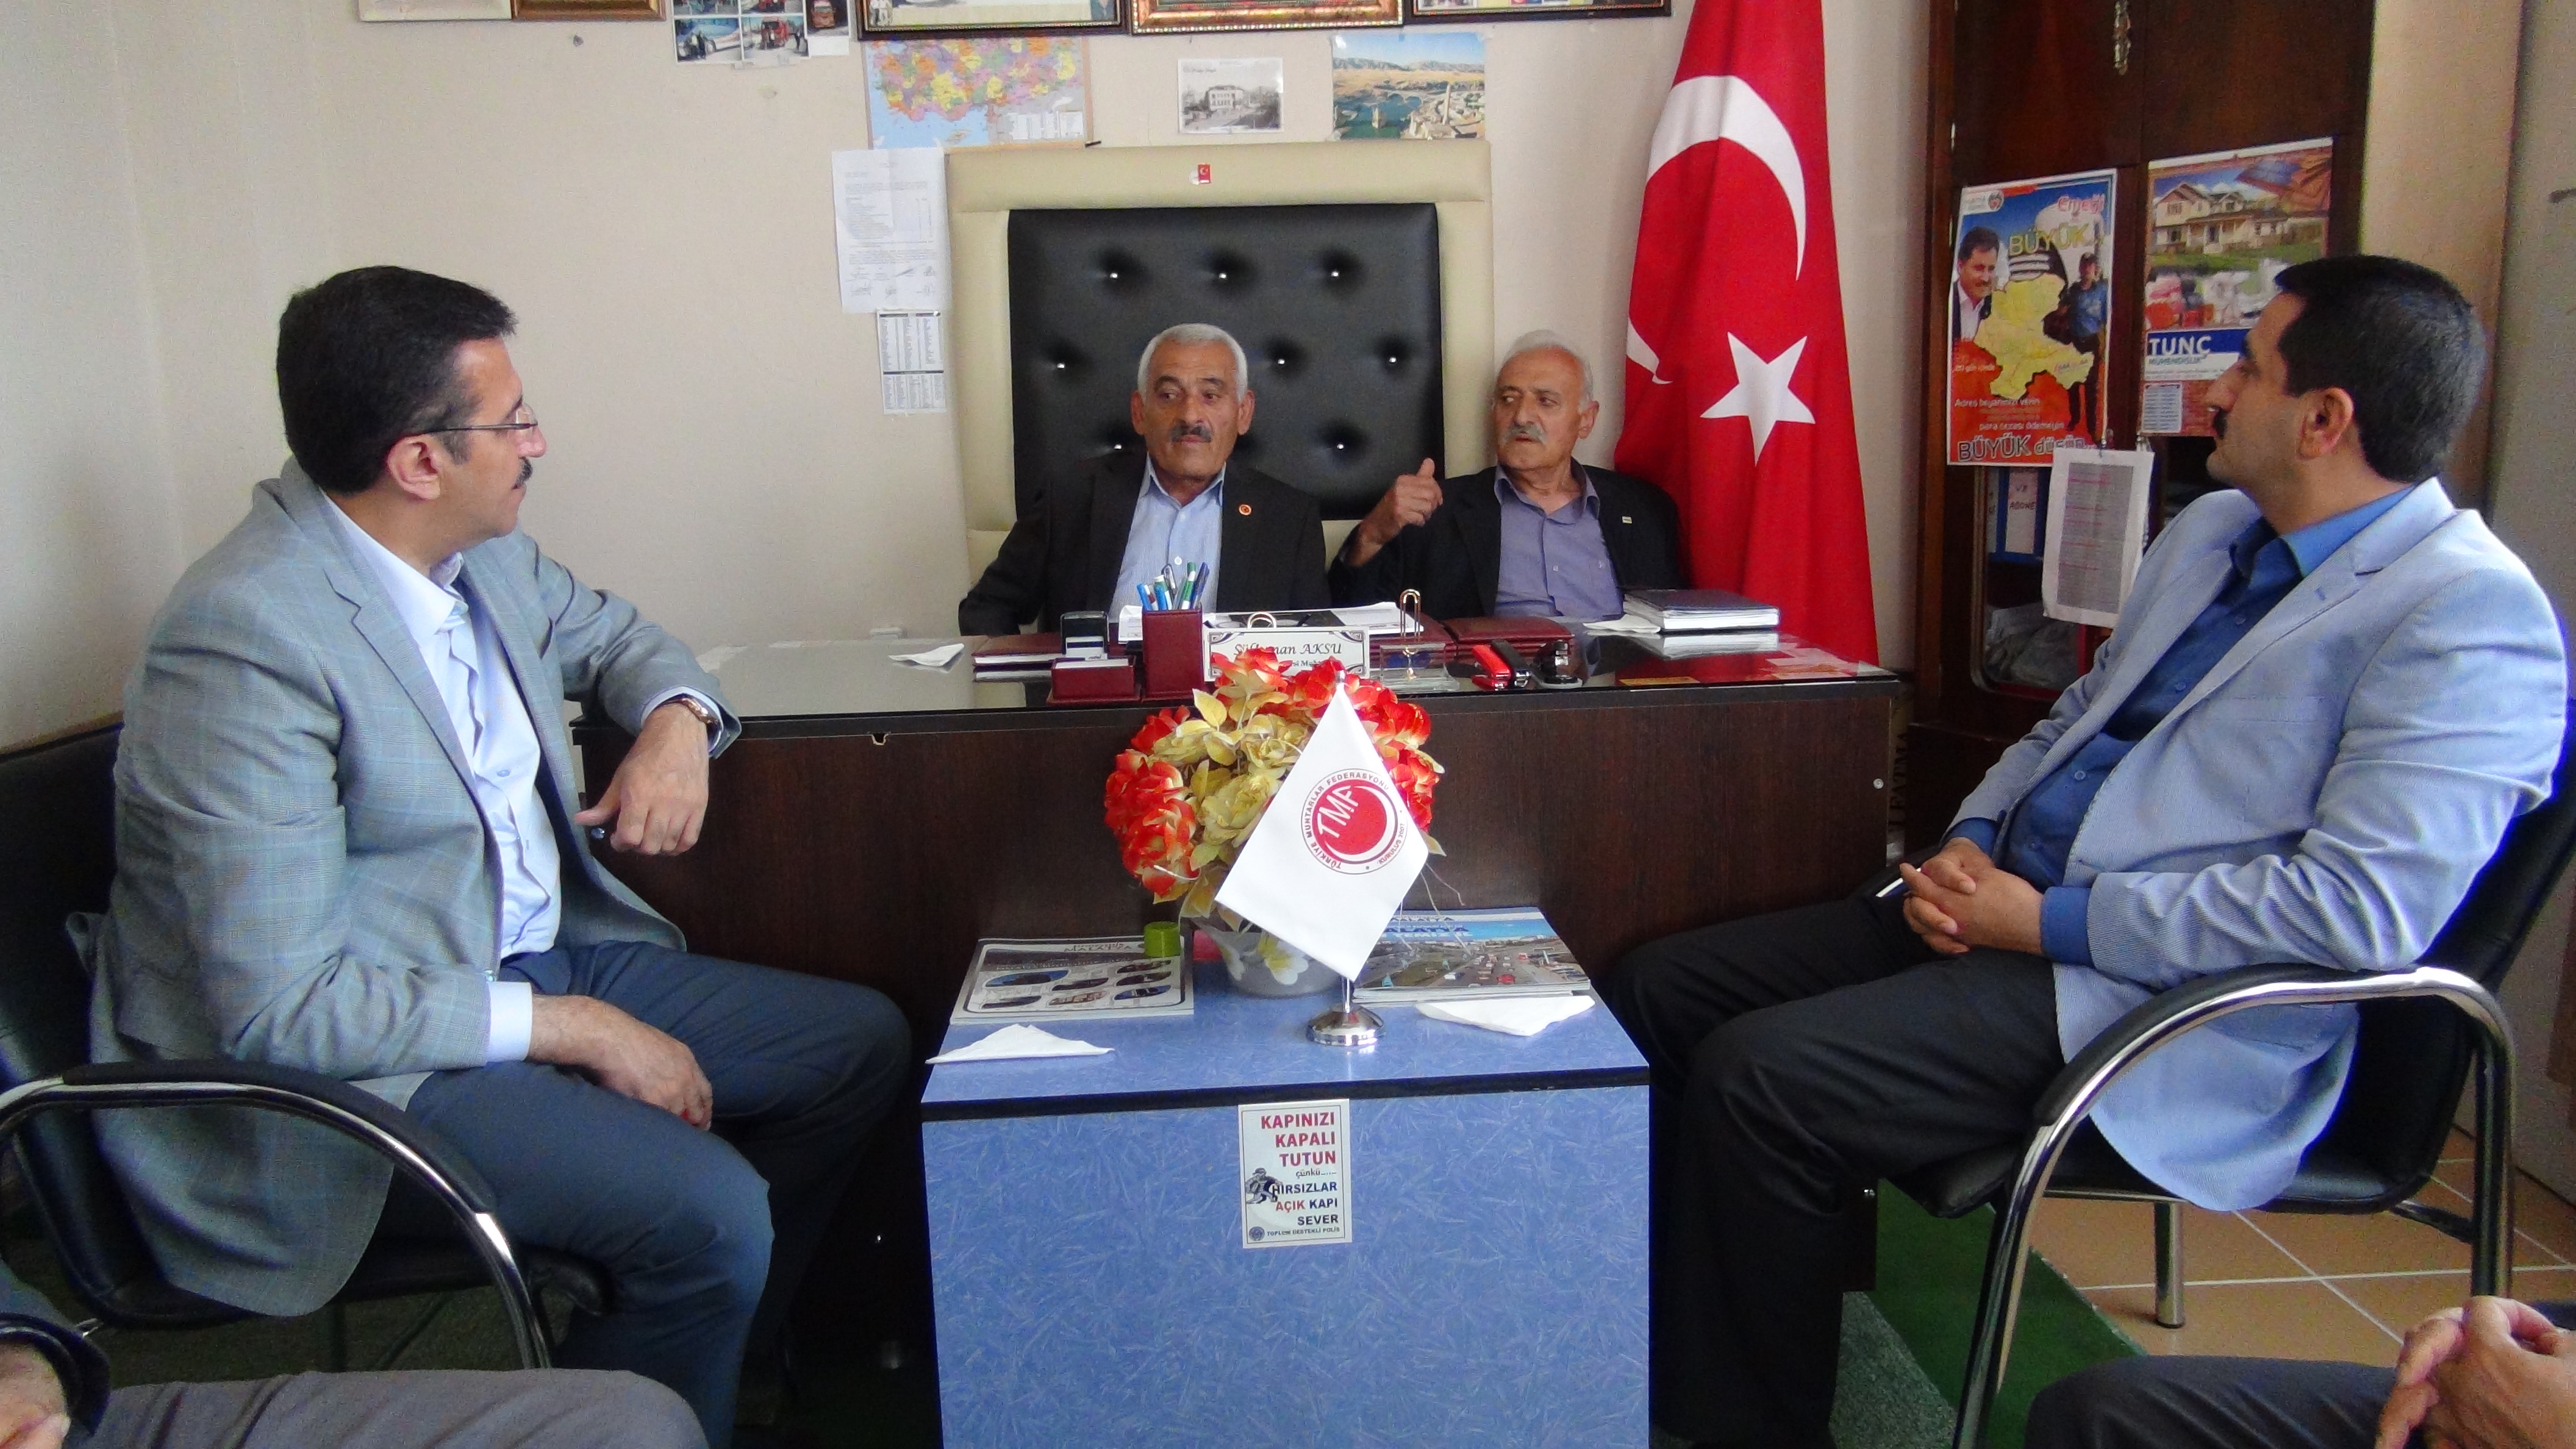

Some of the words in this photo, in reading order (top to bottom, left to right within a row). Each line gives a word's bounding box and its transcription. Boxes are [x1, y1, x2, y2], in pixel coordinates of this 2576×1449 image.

[2009, 223, 2089, 257] BÜYÜK
[1958, 432, 2032, 462] BÜYÜK
[1300, 642, 1342, 655] AKSU
[1326, 771, 1389, 791] FEDERASYONU
[1304, 785, 1325, 839] MUHTARLAR
[1317, 785, 1359, 839] TMF
[1311, 842, 1342, 870] TÜRKİYE
[1261, 1112, 1335, 1129] KAPINIZI
[1275, 1131, 1336, 1148] KAPALI
[1279, 1150, 1336, 1167] TUTUN
[1272, 1181, 1337, 1195] HIRSIZLAR
[1275, 1200, 1306, 1214] AÇIK
[1309, 1198, 1338, 1209] KAPI
[1297, 1214, 1339, 1226] SEVER
